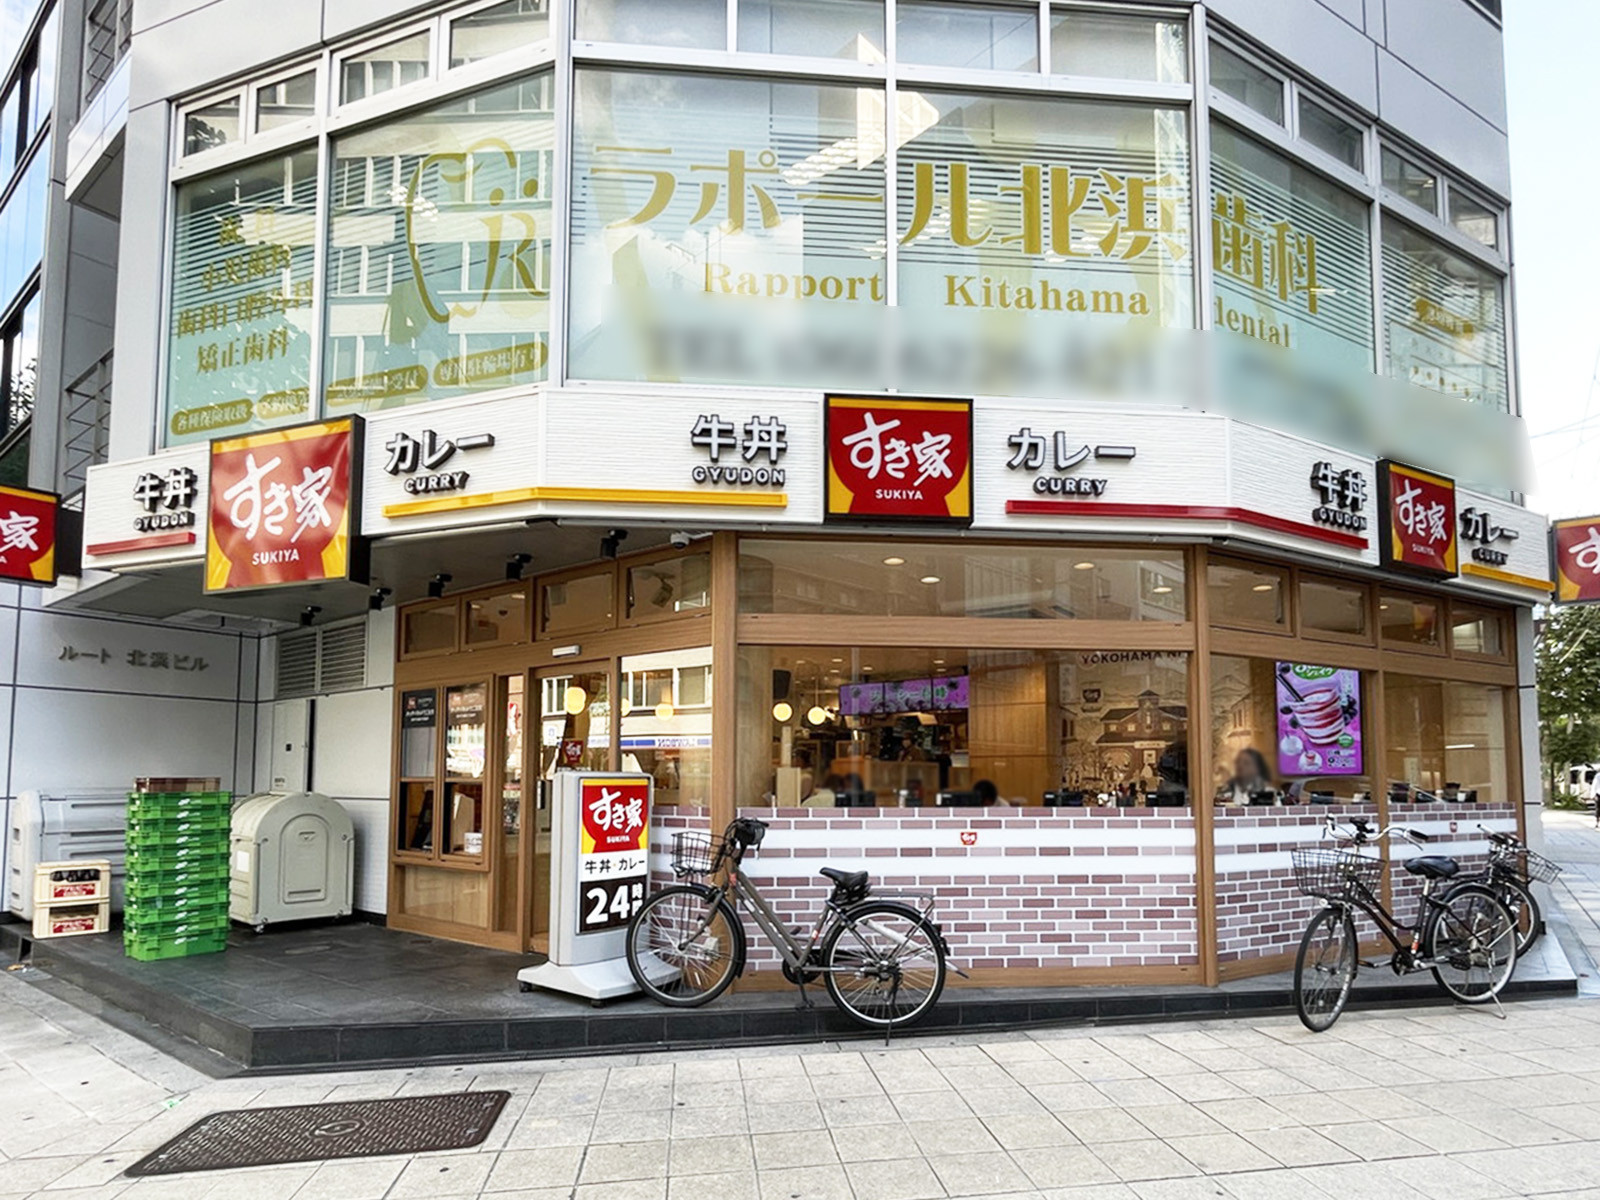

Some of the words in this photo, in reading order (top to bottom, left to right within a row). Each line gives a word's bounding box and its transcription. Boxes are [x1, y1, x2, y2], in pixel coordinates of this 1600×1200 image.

[1211, 192, 1322, 315] 歯科
[704, 262, 885, 300] Rapport
[945, 274, 1151, 315] Kitahama
[198, 327, 289, 374] 矯正歯科
[384, 429, 495, 476] カレー
[689, 414, 788, 464] 牛丼
[841, 412, 953, 487] すき家
[1006, 428, 1135, 471] カレー
[133, 467, 198, 513] 牛丼
[404, 471, 470, 495] CURRY
[691, 465, 786, 486] GYUDON
[875, 488, 924, 501] SUKIYA
[1033, 476, 1108, 496] CURRY
[1310, 461, 1367, 513] 牛丼
[223, 453, 333, 543] すき家
[1312, 506, 1367, 533] GYUDON
[1395, 479, 1447, 544] すき家
[133, 510, 195, 533] GYUDON
[1459, 507, 1519, 545] カレー
[251, 548, 300, 566] SUKIYA
[58, 645, 112, 665] ルート
[588, 787, 643, 833] すき家
[606, 835, 630, 844] SUKIYA
